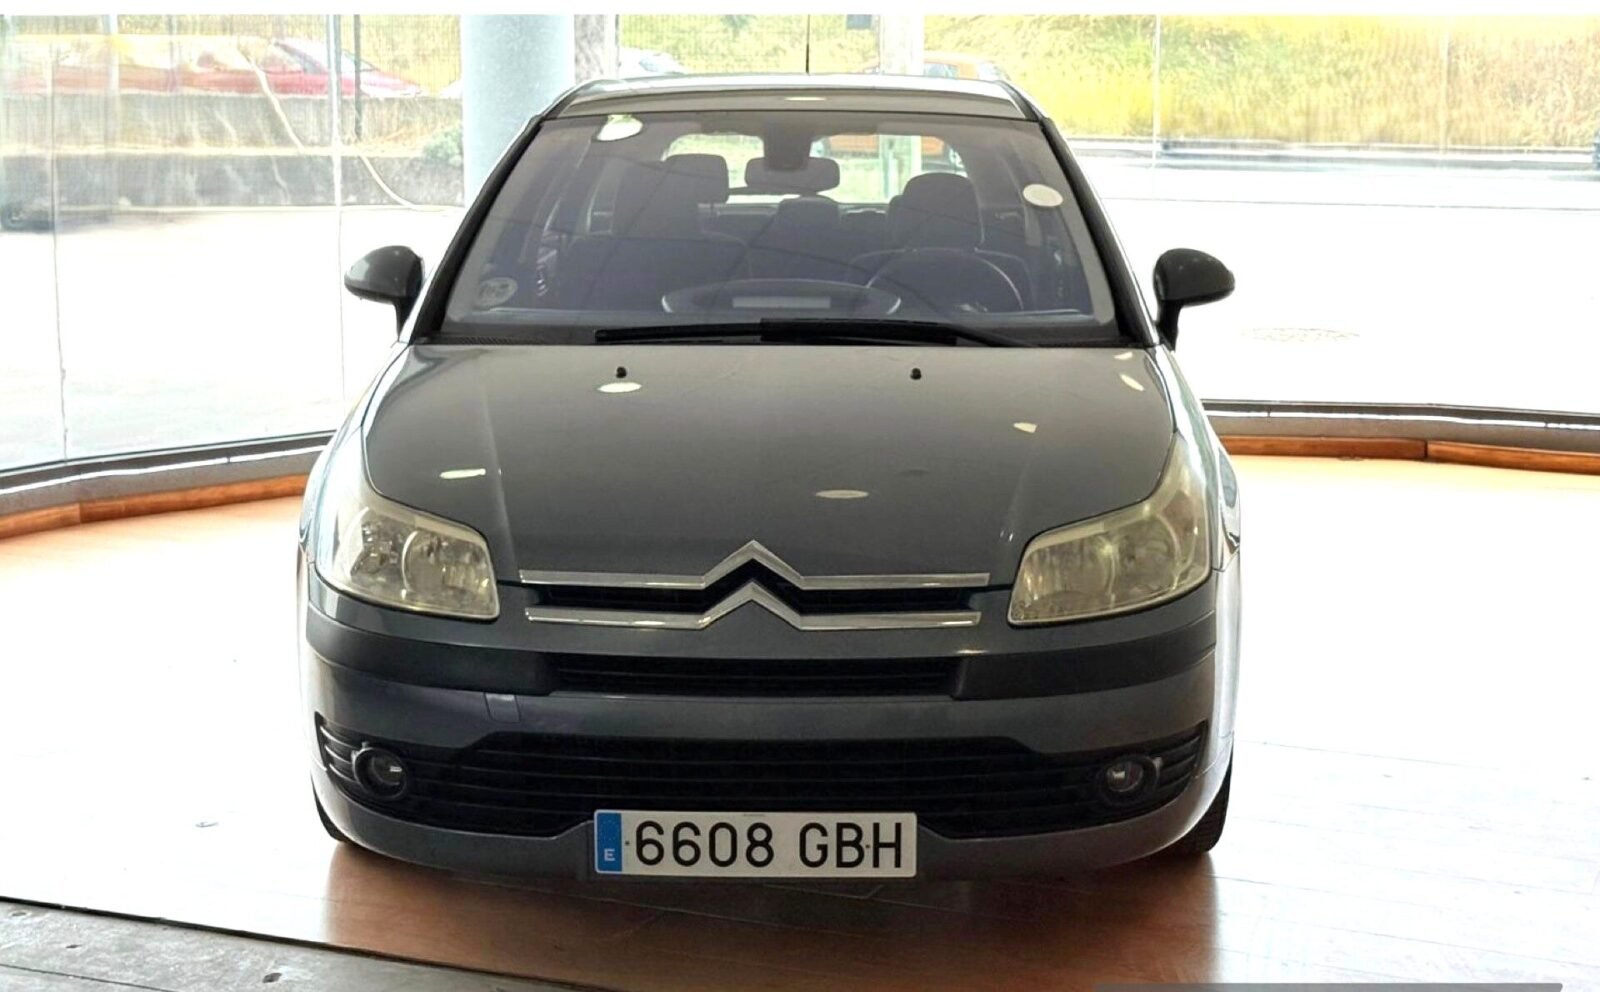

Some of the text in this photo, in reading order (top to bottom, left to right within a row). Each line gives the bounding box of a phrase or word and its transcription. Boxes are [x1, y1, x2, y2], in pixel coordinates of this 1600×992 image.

[604, 820, 902, 868] E 6608 GBH
